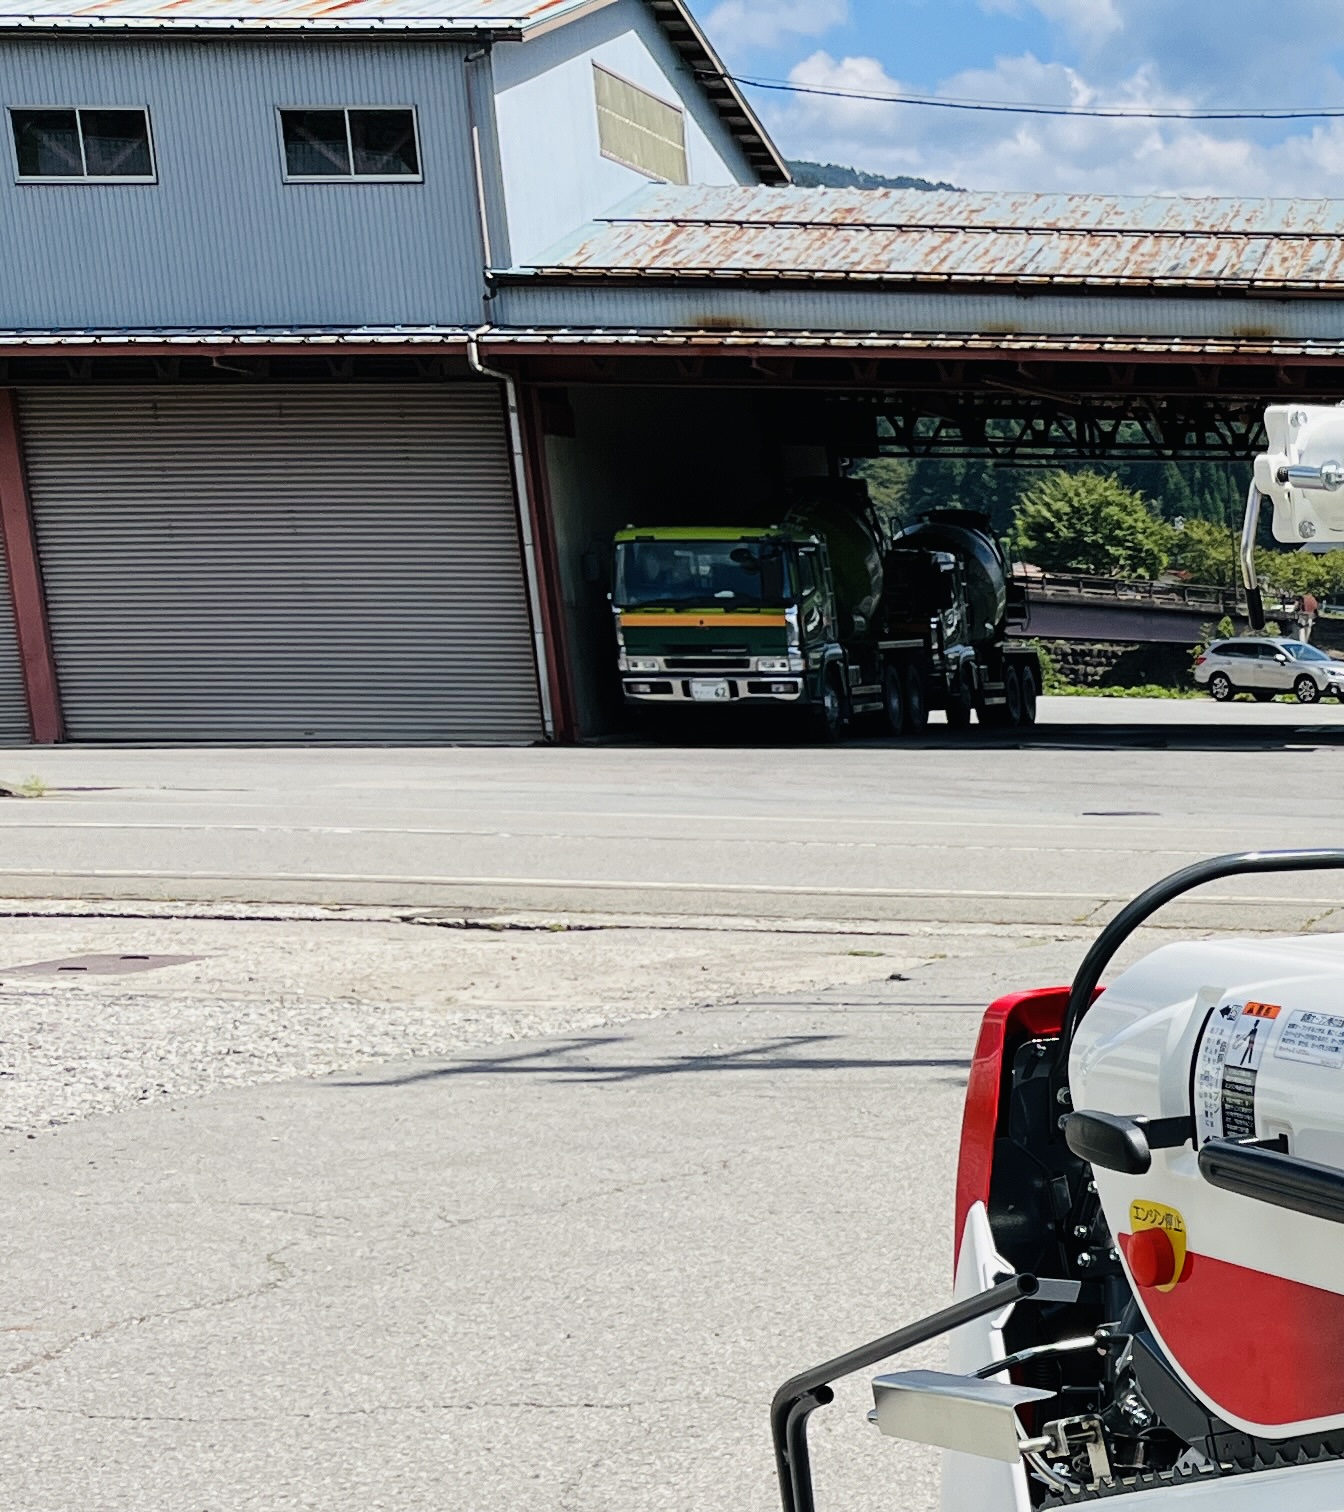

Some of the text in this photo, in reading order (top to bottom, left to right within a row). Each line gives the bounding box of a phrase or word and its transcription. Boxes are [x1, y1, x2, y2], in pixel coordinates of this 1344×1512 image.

[1133, 1206, 1182, 1232] エンジン停止
